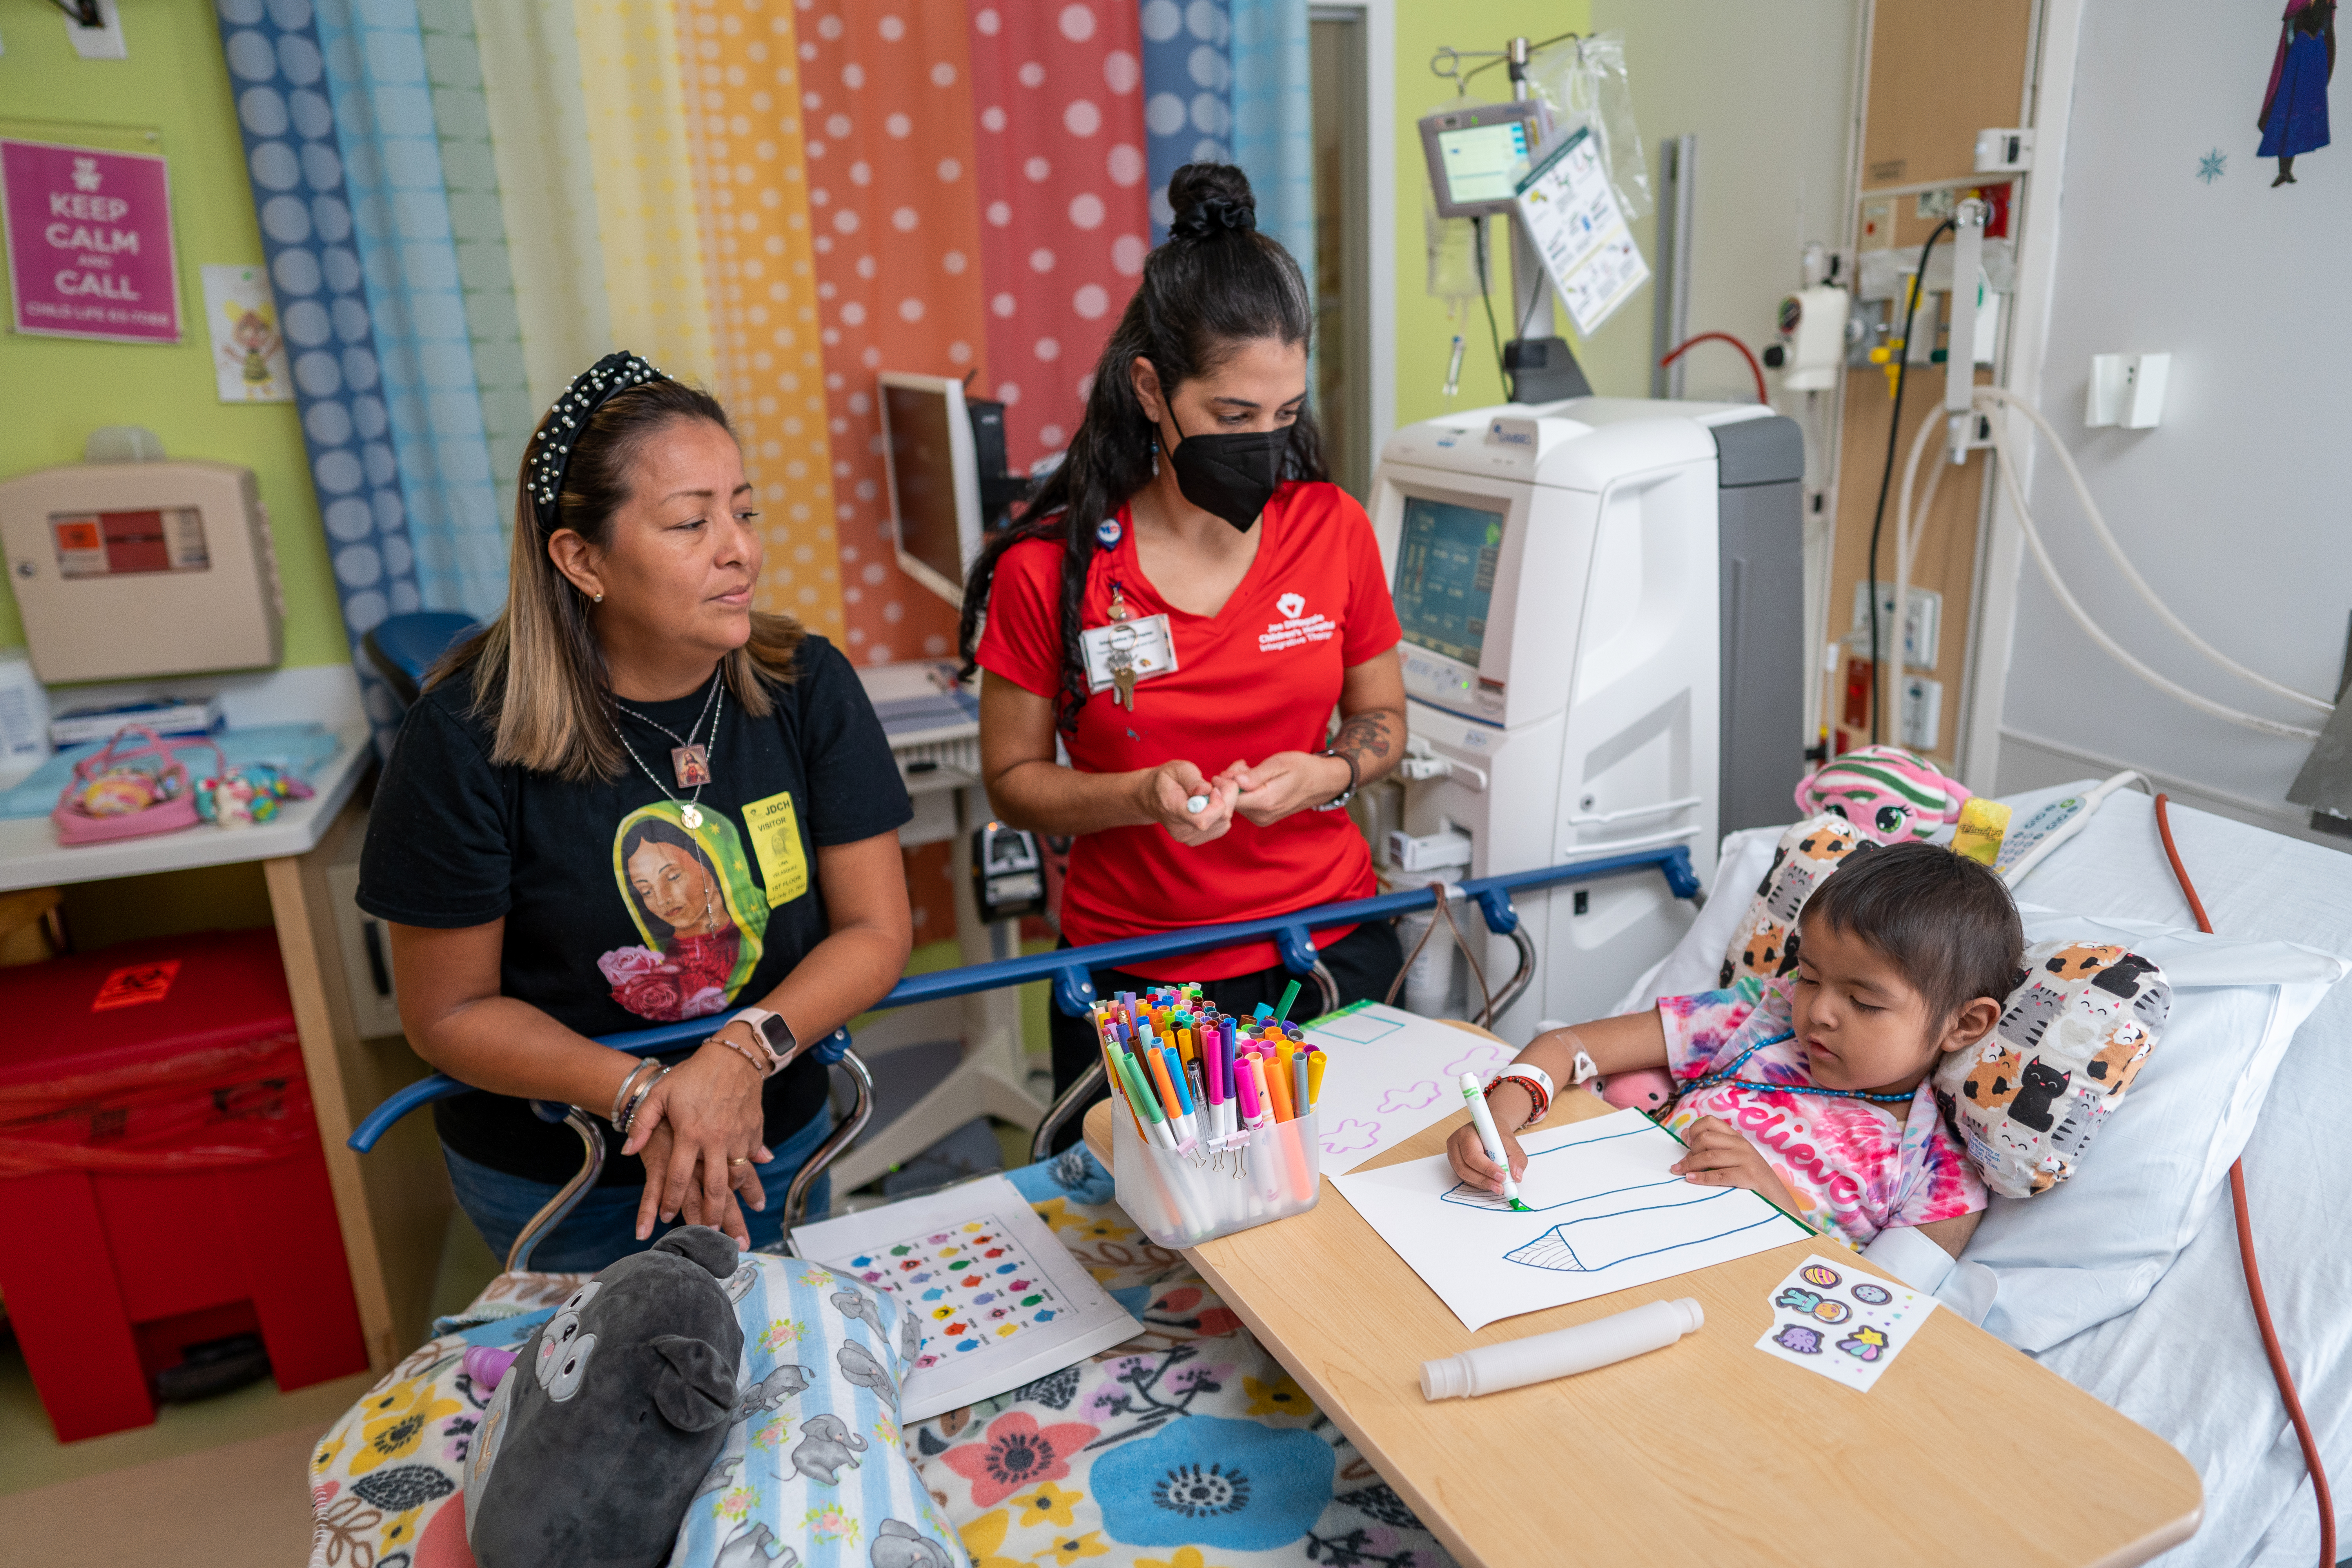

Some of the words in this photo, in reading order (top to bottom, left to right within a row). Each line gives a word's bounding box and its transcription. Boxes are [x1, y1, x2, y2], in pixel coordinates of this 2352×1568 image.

[49, 192, 129, 222] KEEP
[45, 222, 140, 256] CALM
[54, 269, 141, 301] CALL
[1267, 623, 1284, 633] Joe
[766, 800, 790, 815] JDCH
[758, 816, 786, 831] VISITOR
[783, 875, 801, 887] FLOOR
[1978, 1142, 1994, 1154] Ministry
[1985, 1151, 2000, 1162] Church
